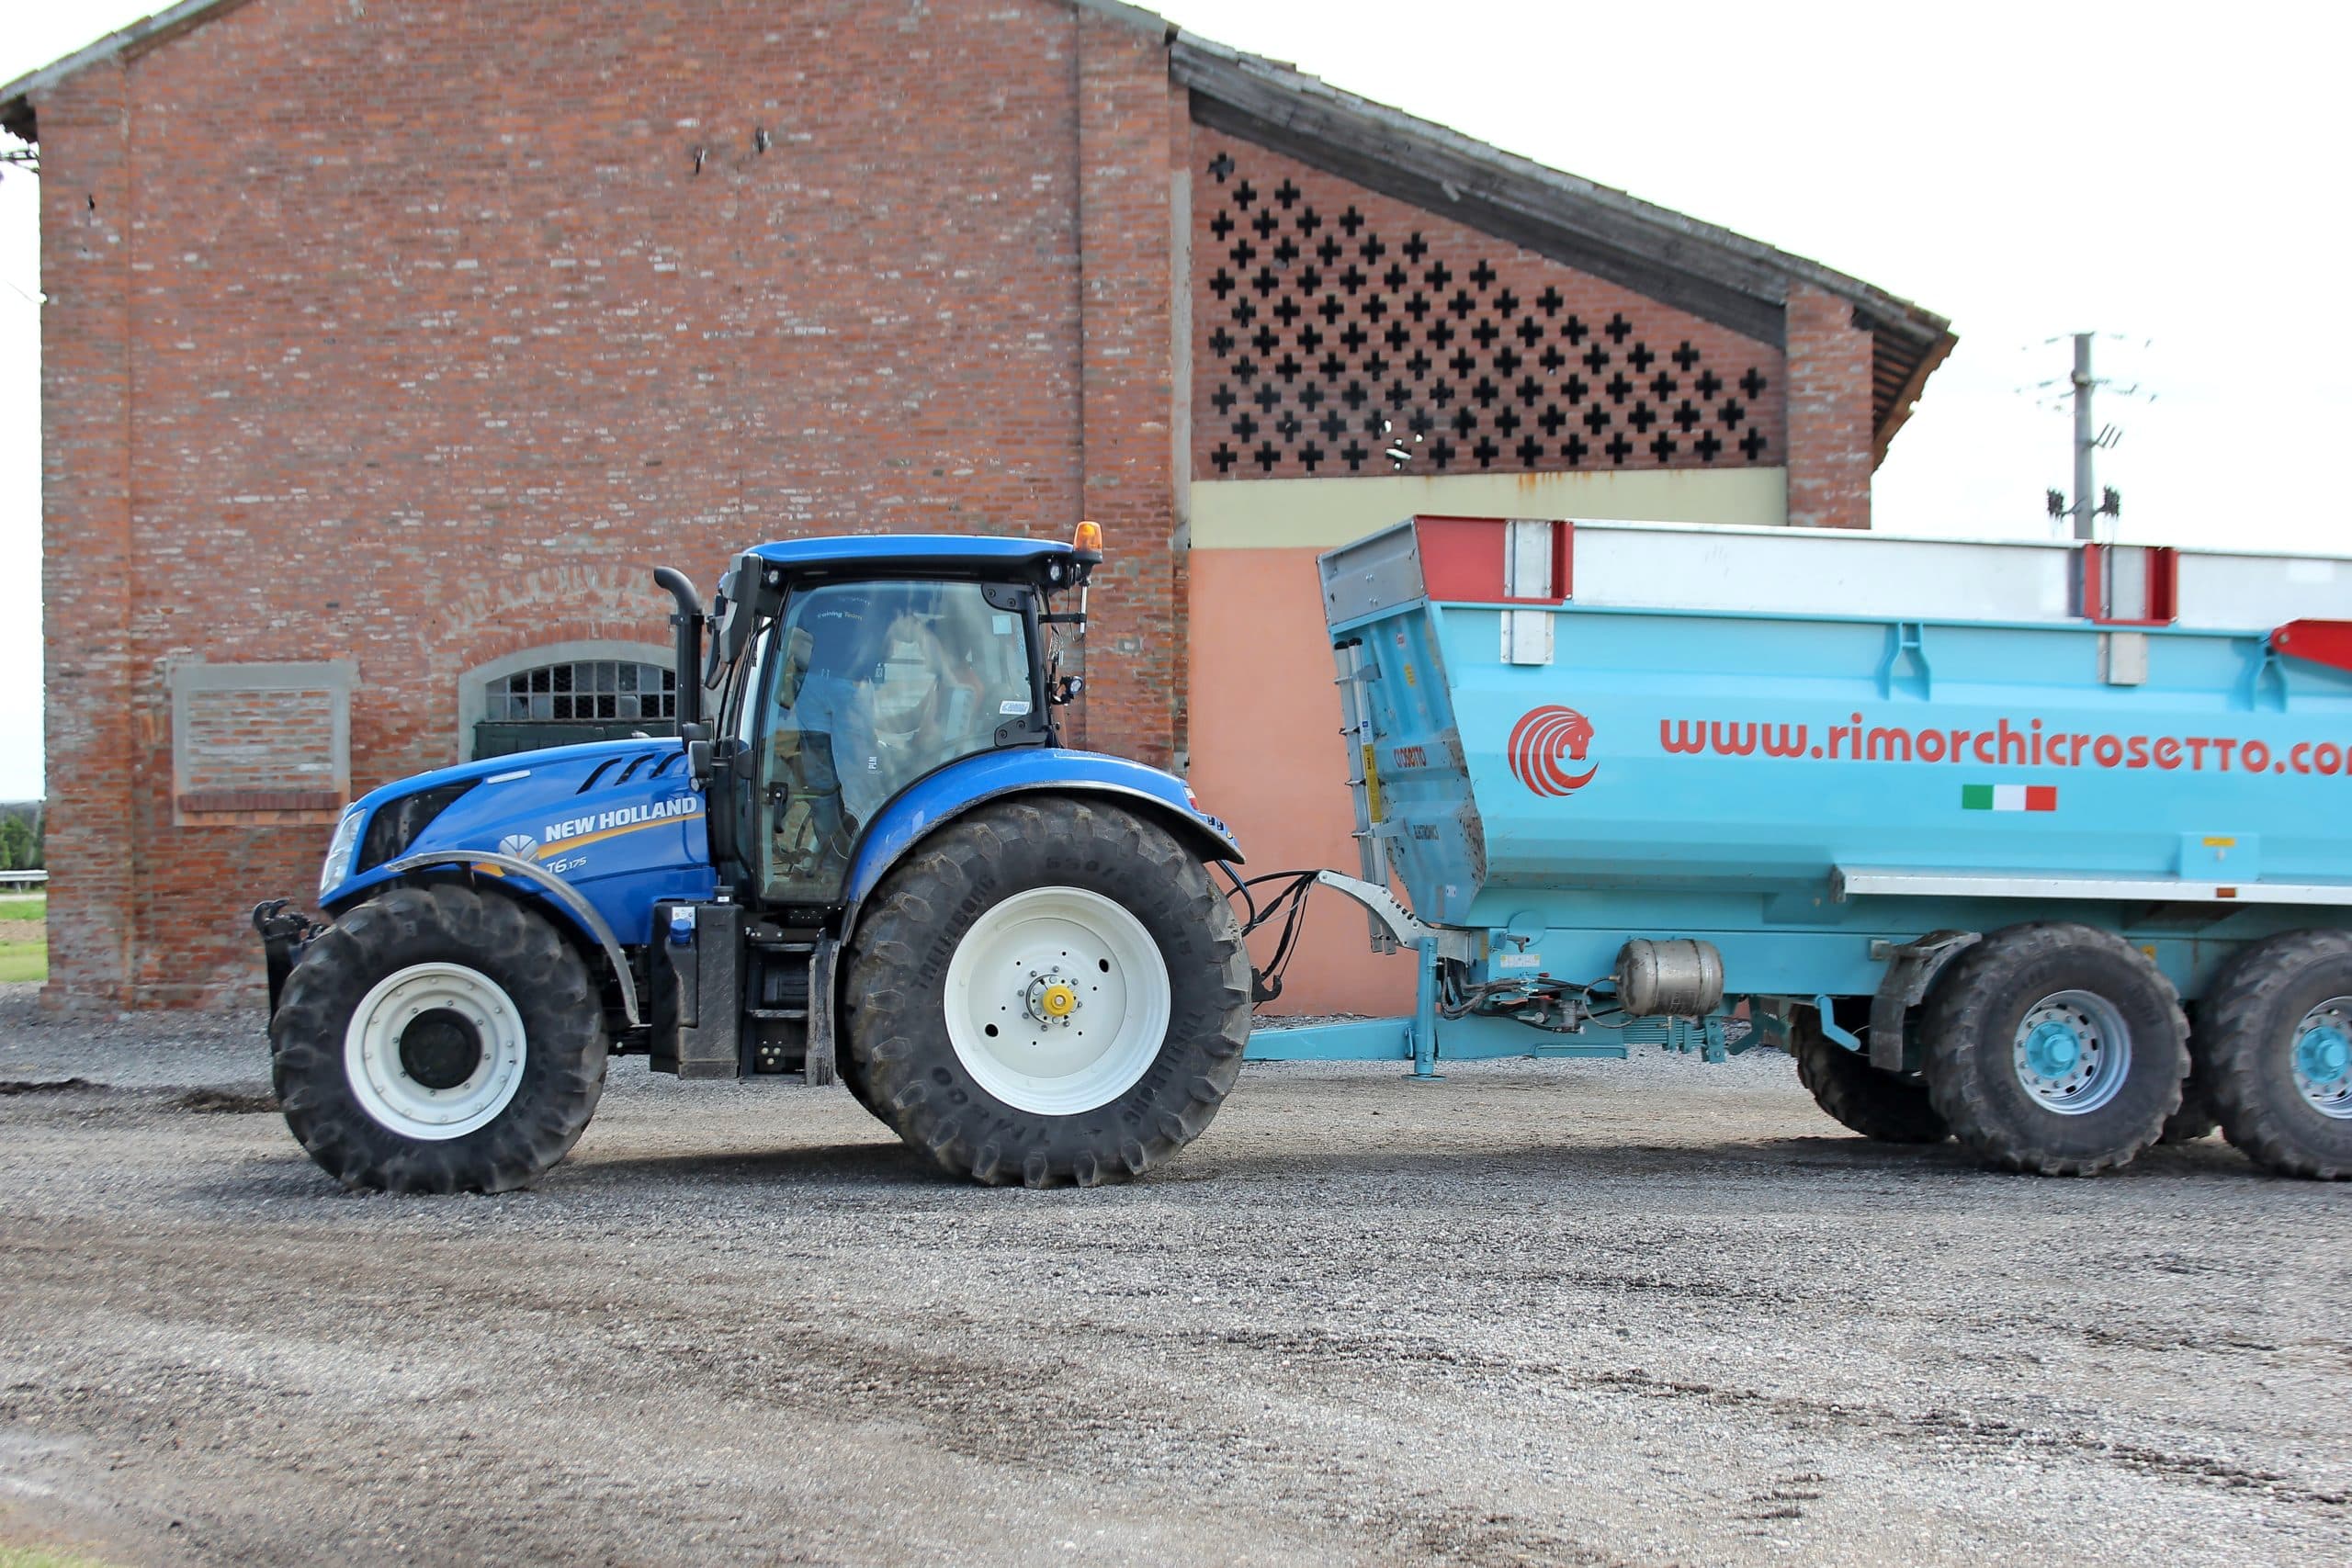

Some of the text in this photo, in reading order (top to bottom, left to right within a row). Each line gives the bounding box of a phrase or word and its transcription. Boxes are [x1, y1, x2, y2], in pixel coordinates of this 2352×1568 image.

[545, 796, 698, 842] NEW HOLLAND
[546, 856, 588, 874] T6.175
